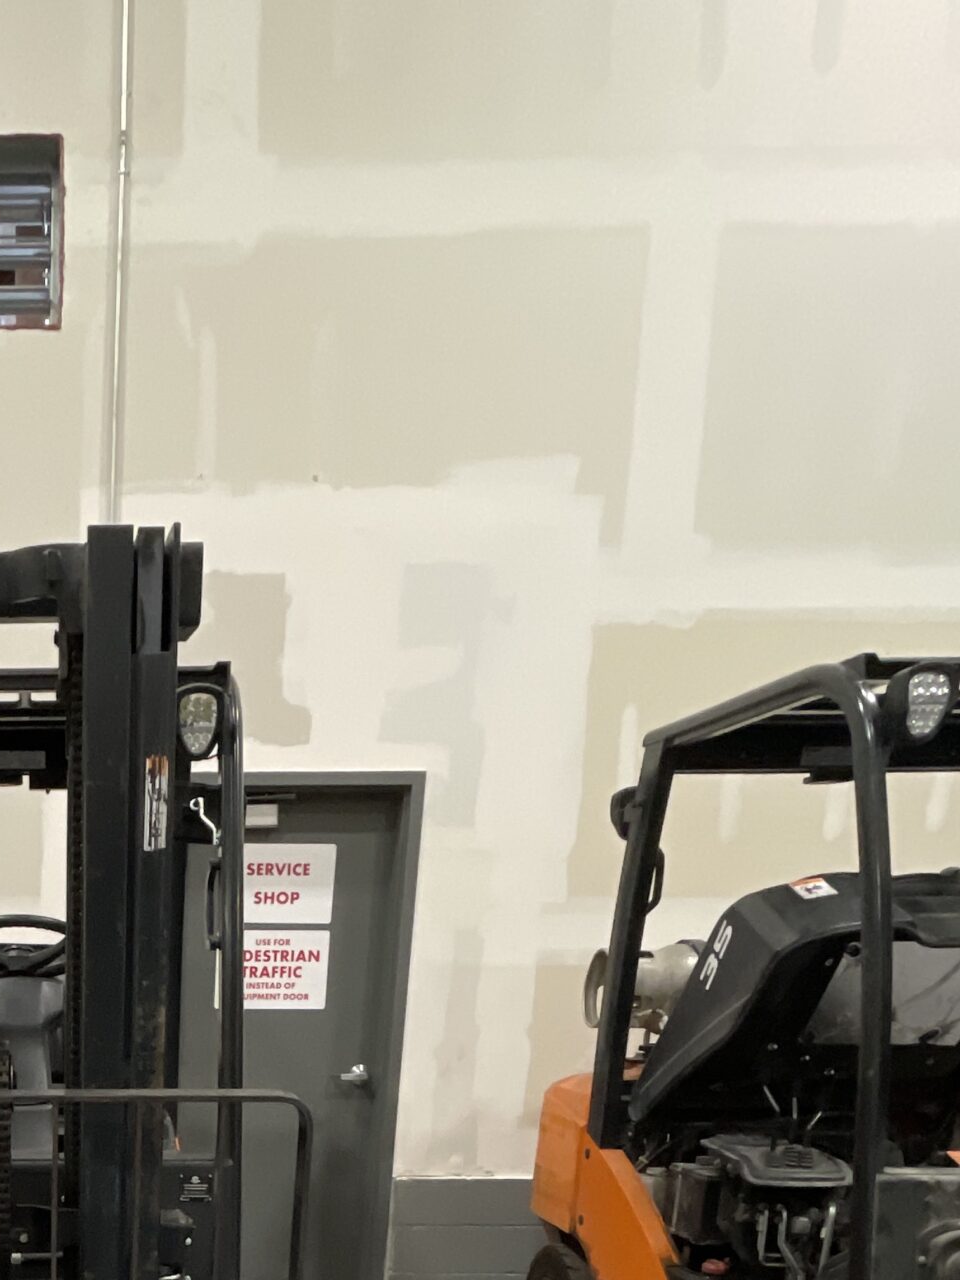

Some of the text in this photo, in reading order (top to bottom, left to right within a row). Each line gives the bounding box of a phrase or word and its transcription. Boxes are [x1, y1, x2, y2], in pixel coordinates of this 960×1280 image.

[246, 862, 311, 876] SERVICE
[253, 891, 300, 905] SHOP
[255, 938, 291, 946] USE FOR
[243, 949, 321, 963] DESTRIAN
[700, 920, 733, 991] 35
[242, 965, 303, 979] TRAFFIC
[246, 982, 296, 990] INSTEAD OF
[243, 993, 309, 1001] UIPMENT DOOR
